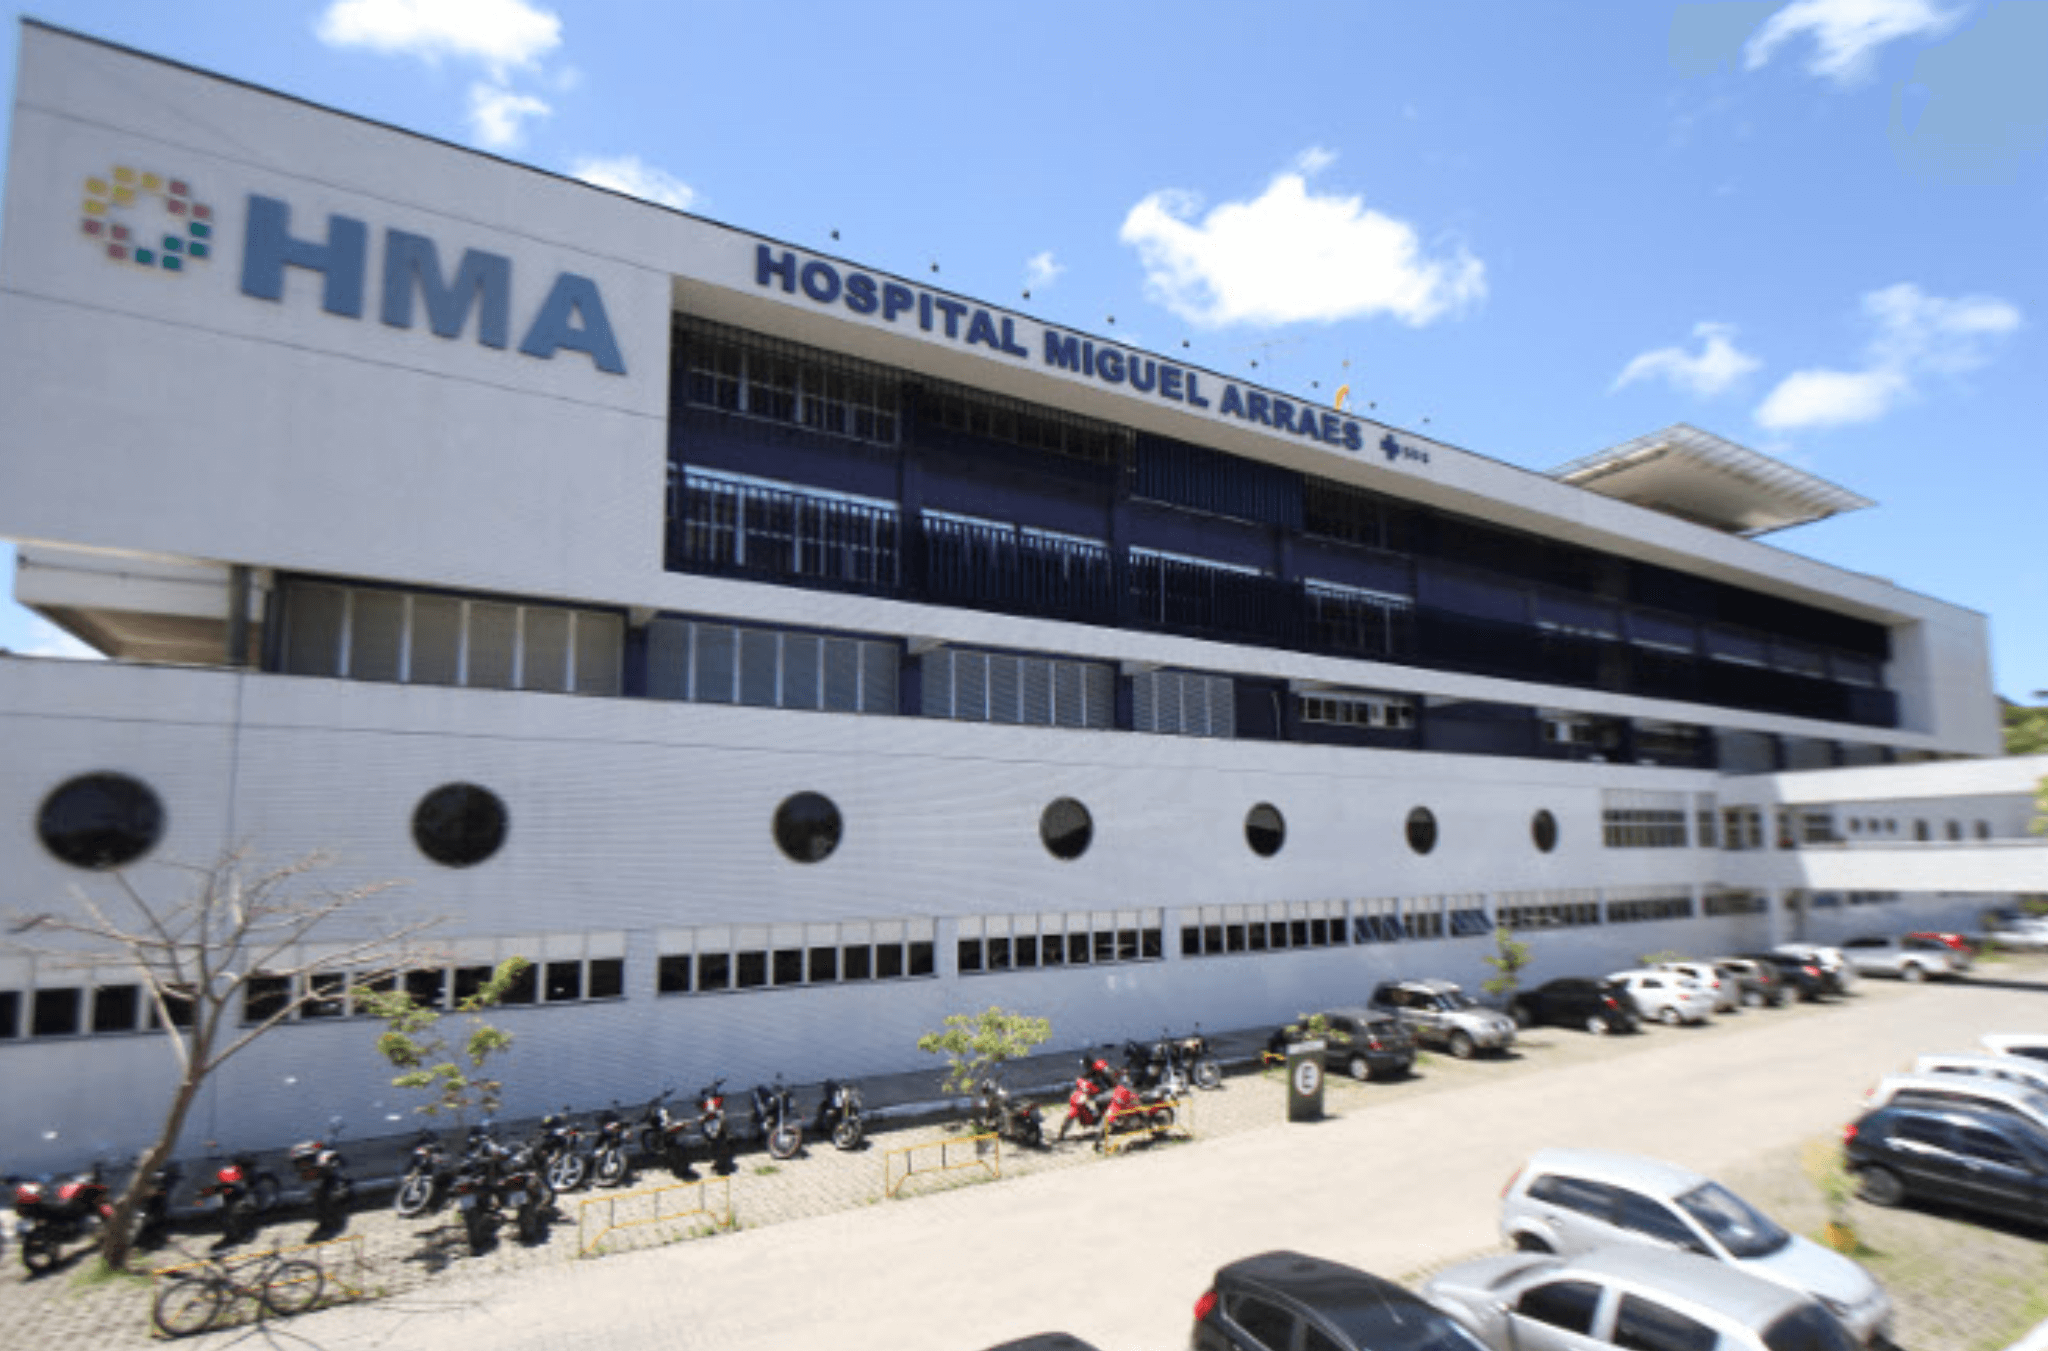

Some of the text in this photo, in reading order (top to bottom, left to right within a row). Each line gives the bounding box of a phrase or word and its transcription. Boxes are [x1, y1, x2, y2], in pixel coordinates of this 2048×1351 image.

[241, 193, 628, 376] HMA
[756, 243, 1364, 452] HOSPITAL MIGUEL ARRAES
